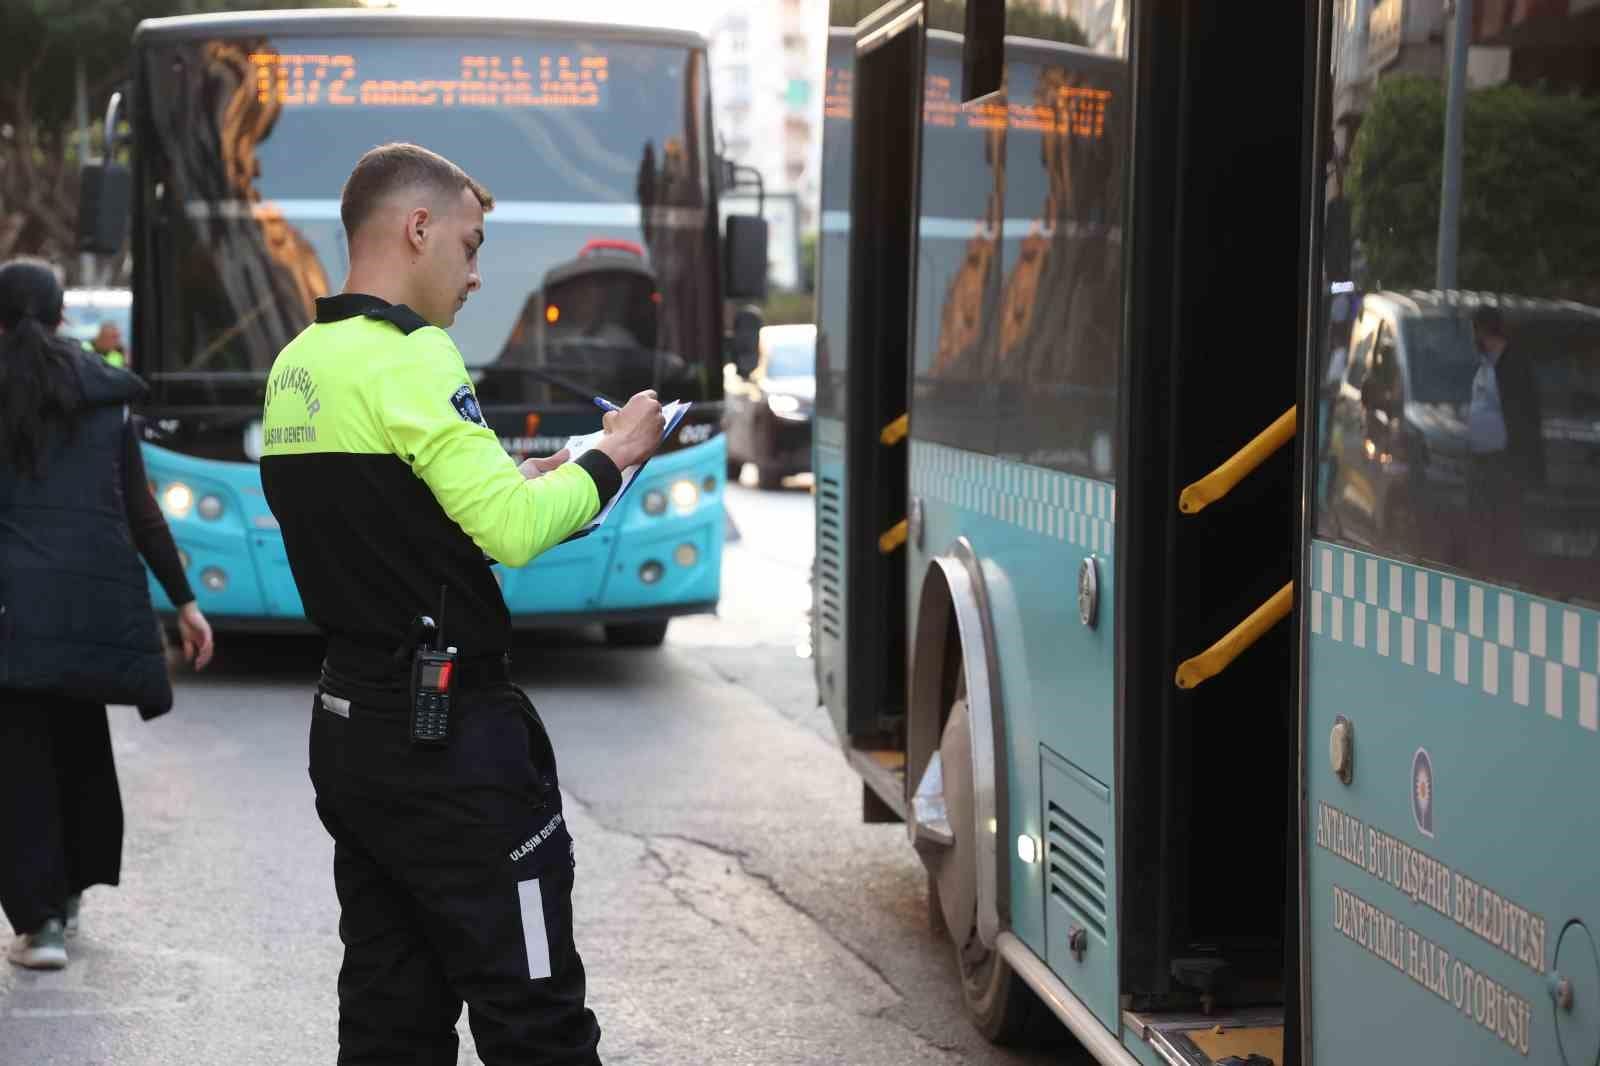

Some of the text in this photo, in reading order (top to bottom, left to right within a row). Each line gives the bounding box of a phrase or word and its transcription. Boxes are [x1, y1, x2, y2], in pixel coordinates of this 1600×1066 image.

[509, 834, 541, 861] ULAŞIM
[1316, 800, 1545, 975] ANTALYA BÜYÜKŞEHİR BELEDİYESİ
[1333, 885, 1530, 1055] DENETİMLİ HALK OTOBÜSÜ
